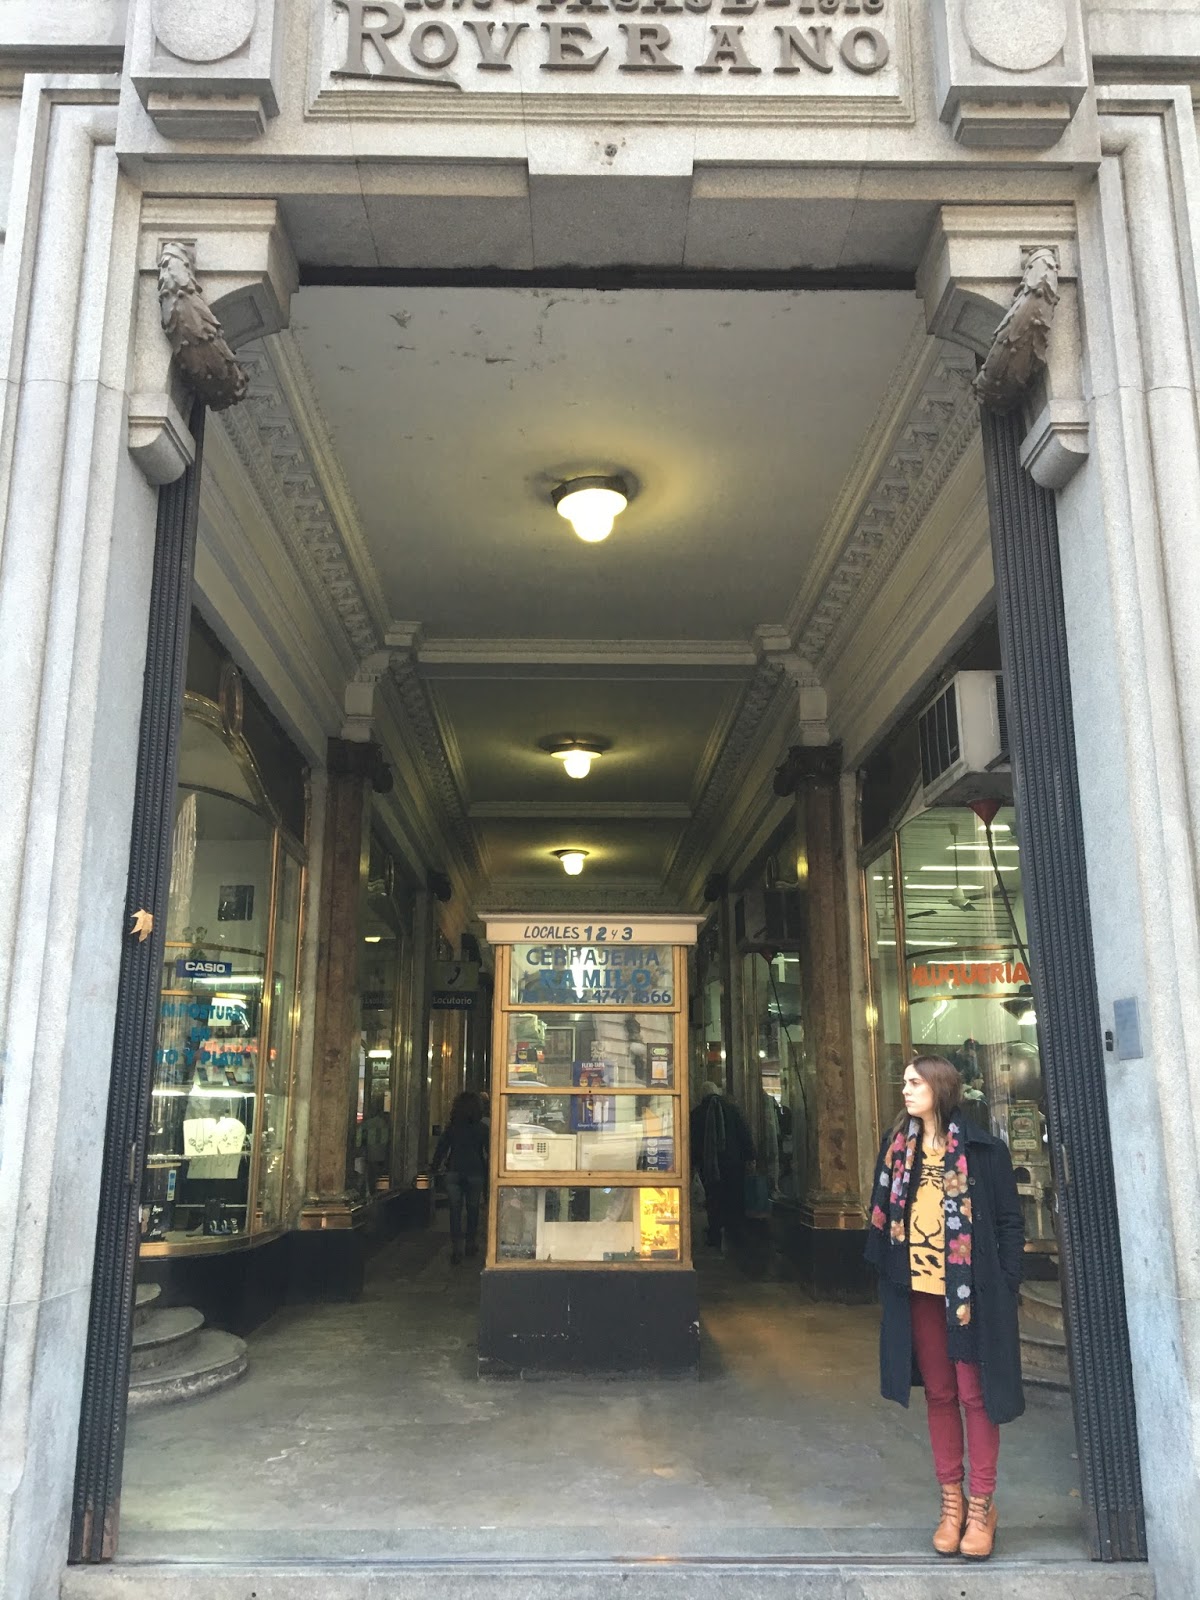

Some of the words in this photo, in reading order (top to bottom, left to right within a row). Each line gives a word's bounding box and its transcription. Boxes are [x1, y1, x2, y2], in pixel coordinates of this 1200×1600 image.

[331, 0, 890, 90] ROVERANO
[524, 926, 580, 939] LOCALES
[584, 926, 593, 941] 1
[596, 927, 607, 941] 2
[621, 927, 633, 940] 3
[185, 962, 226, 973] CASIO
[432, 996, 472, 1005] Locutorio
